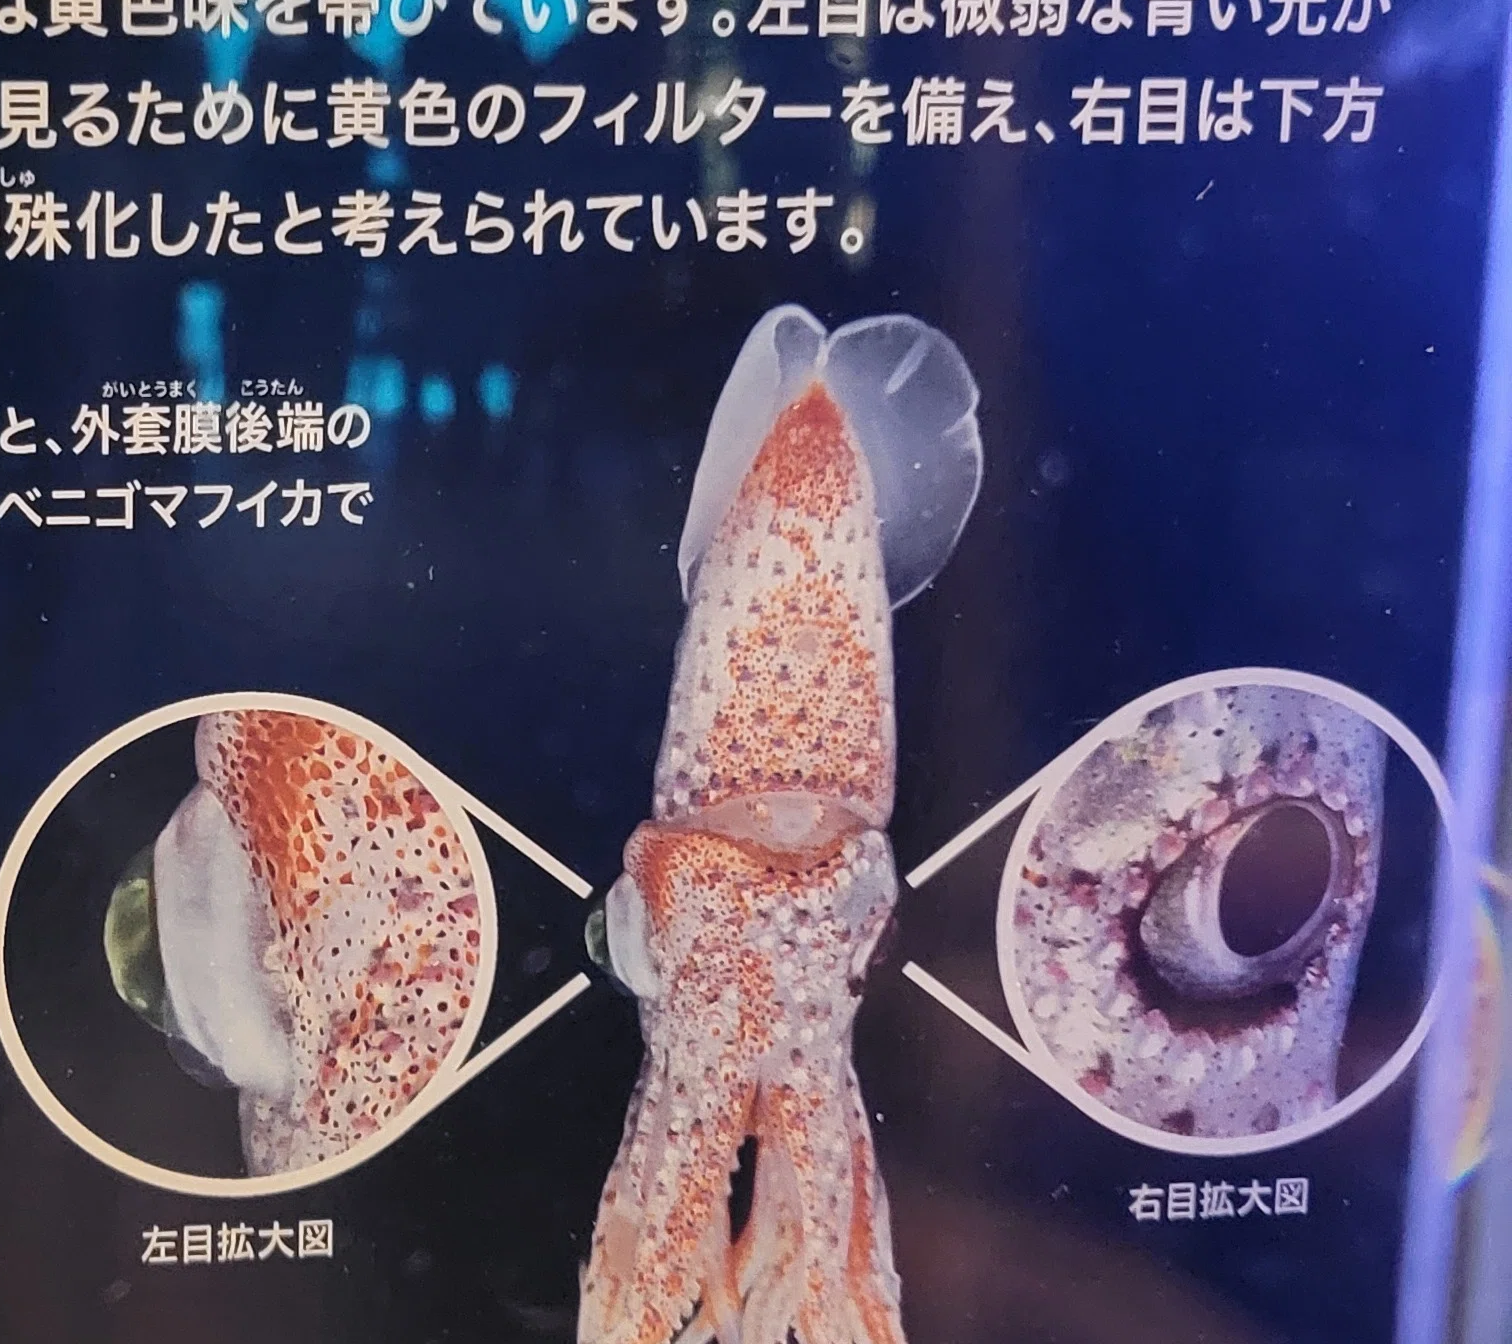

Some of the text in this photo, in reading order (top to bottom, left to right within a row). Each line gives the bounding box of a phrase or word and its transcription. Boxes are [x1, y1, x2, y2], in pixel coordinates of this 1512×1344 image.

[102, 378, 303, 398] がいとうまく こうたん
[1128, 1177, 1309, 1221] 右目拡大図
[142, 1219, 333, 1264] 左目拡大図
